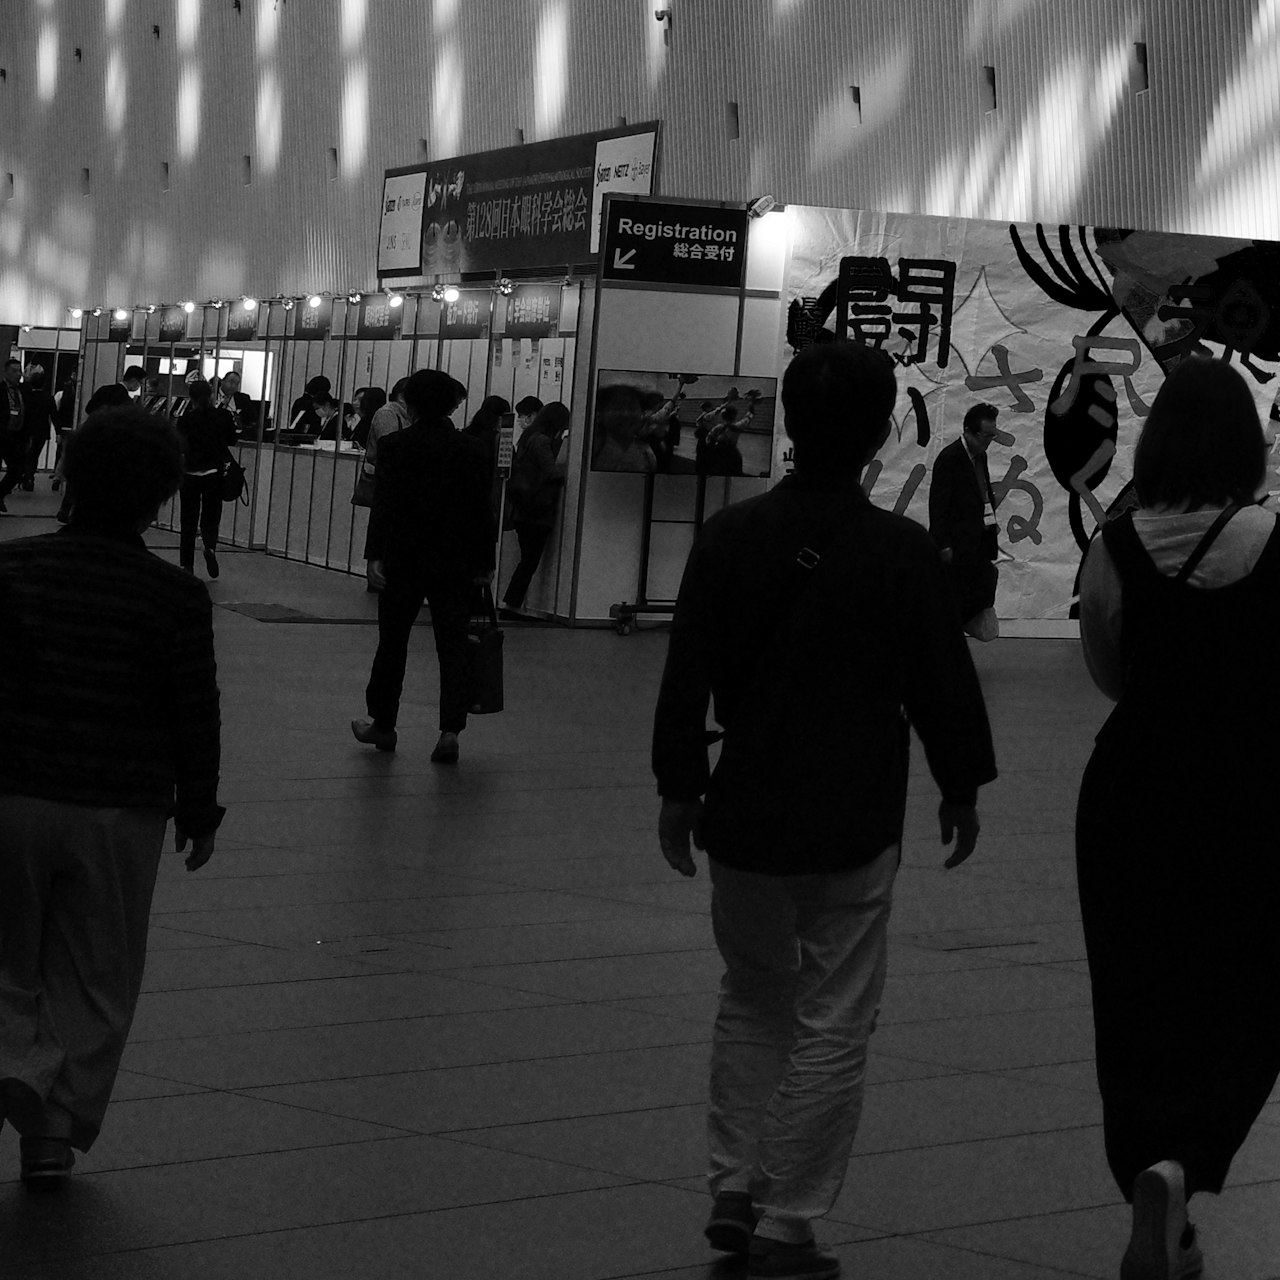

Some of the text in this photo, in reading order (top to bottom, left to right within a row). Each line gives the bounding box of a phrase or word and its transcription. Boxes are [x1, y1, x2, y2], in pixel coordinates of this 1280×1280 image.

[464, 186, 588, 243] 第128回日本眼科学会総会
[618, 218, 737, 243] Registration
[672, 242, 735, 261] 総合受付
